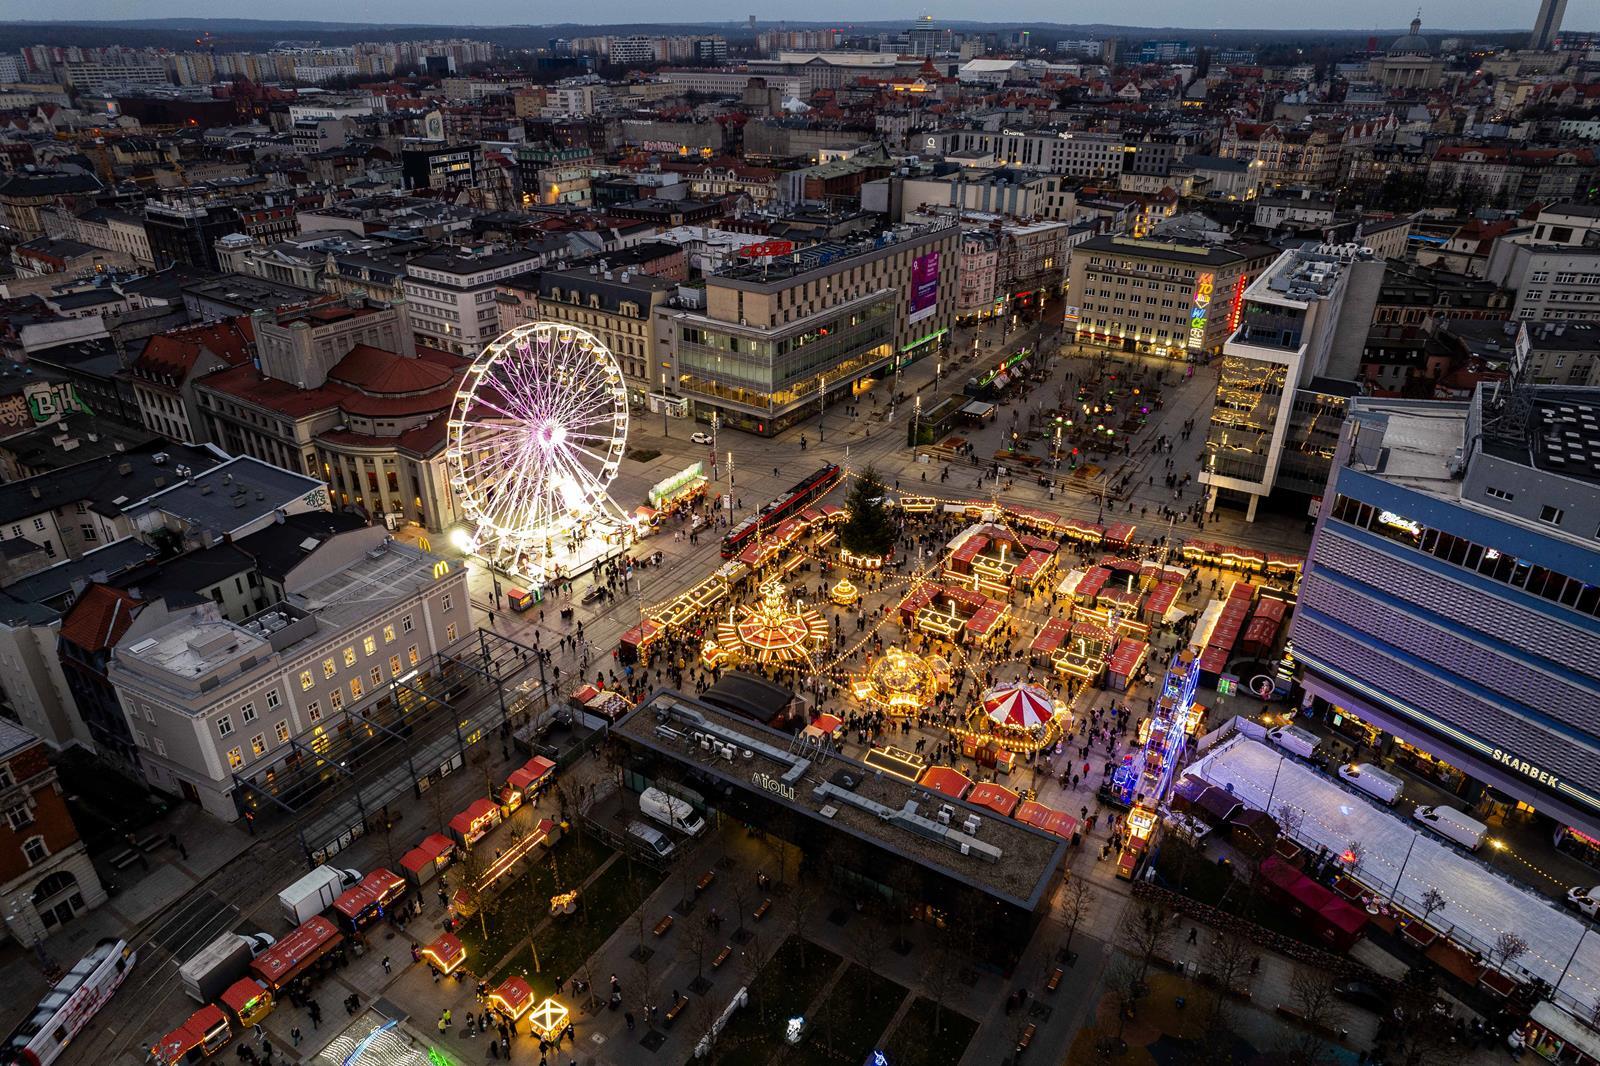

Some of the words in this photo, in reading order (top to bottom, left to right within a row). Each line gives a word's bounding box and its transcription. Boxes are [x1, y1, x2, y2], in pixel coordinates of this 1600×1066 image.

[1199, 283, 1213, 295] TO
[1191, 317, 1208, 329] CE
[1492, 749, 1559, 789] SKARBEK
